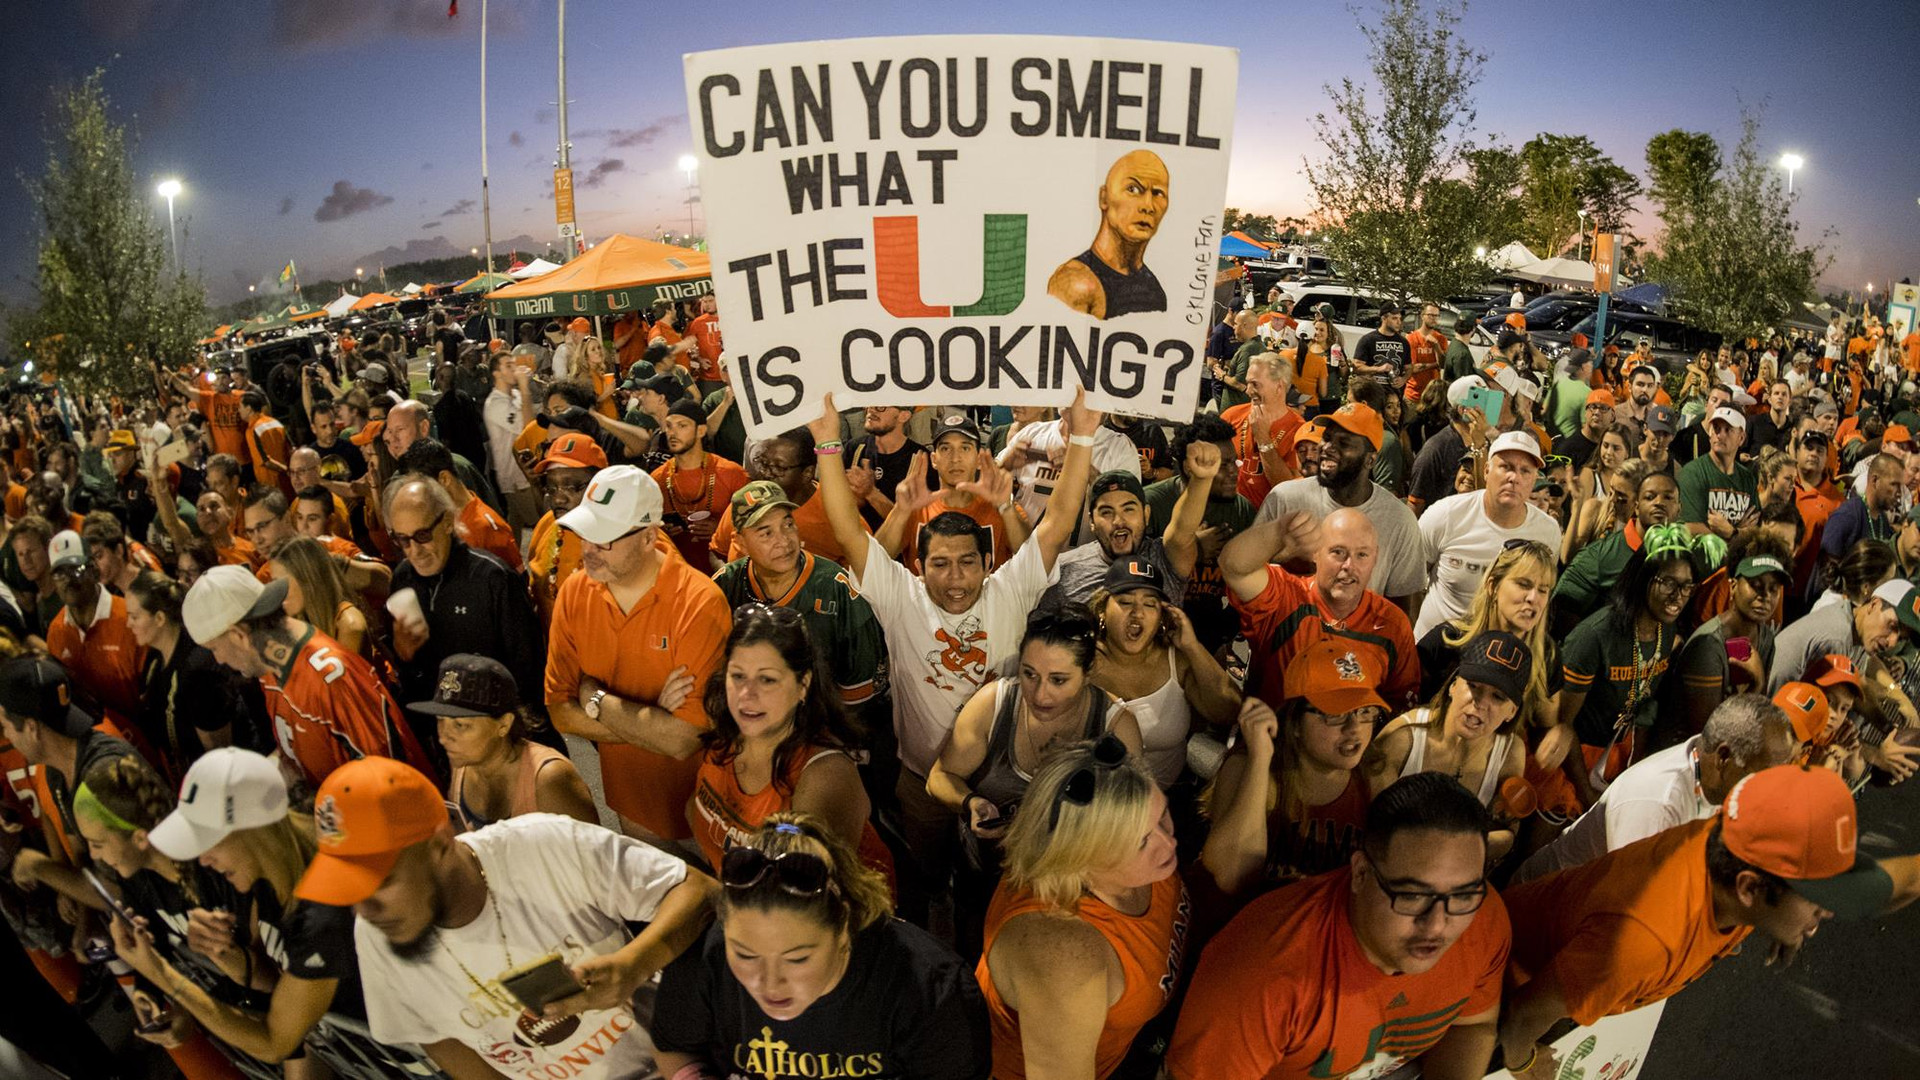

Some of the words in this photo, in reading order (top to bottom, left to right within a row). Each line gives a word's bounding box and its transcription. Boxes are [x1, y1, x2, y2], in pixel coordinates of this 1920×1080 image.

[699, 64, 834, 158] CAN
[852, 57, 988, 141] YOU
[1010, 57, 1222, 150] SMELL
[557, 177, 569, 190] 12
[781, 149, 958, 215] WHAT
[728, 237, 867, 322] THE
[873, 213, 1028, 318] U
[737, 347, 804, 426] IS
[841, 325, 1195, 406] COOKING?
[308, 647, 345, 684] 5
[525, 1008, 634, 1080] CONVIC
